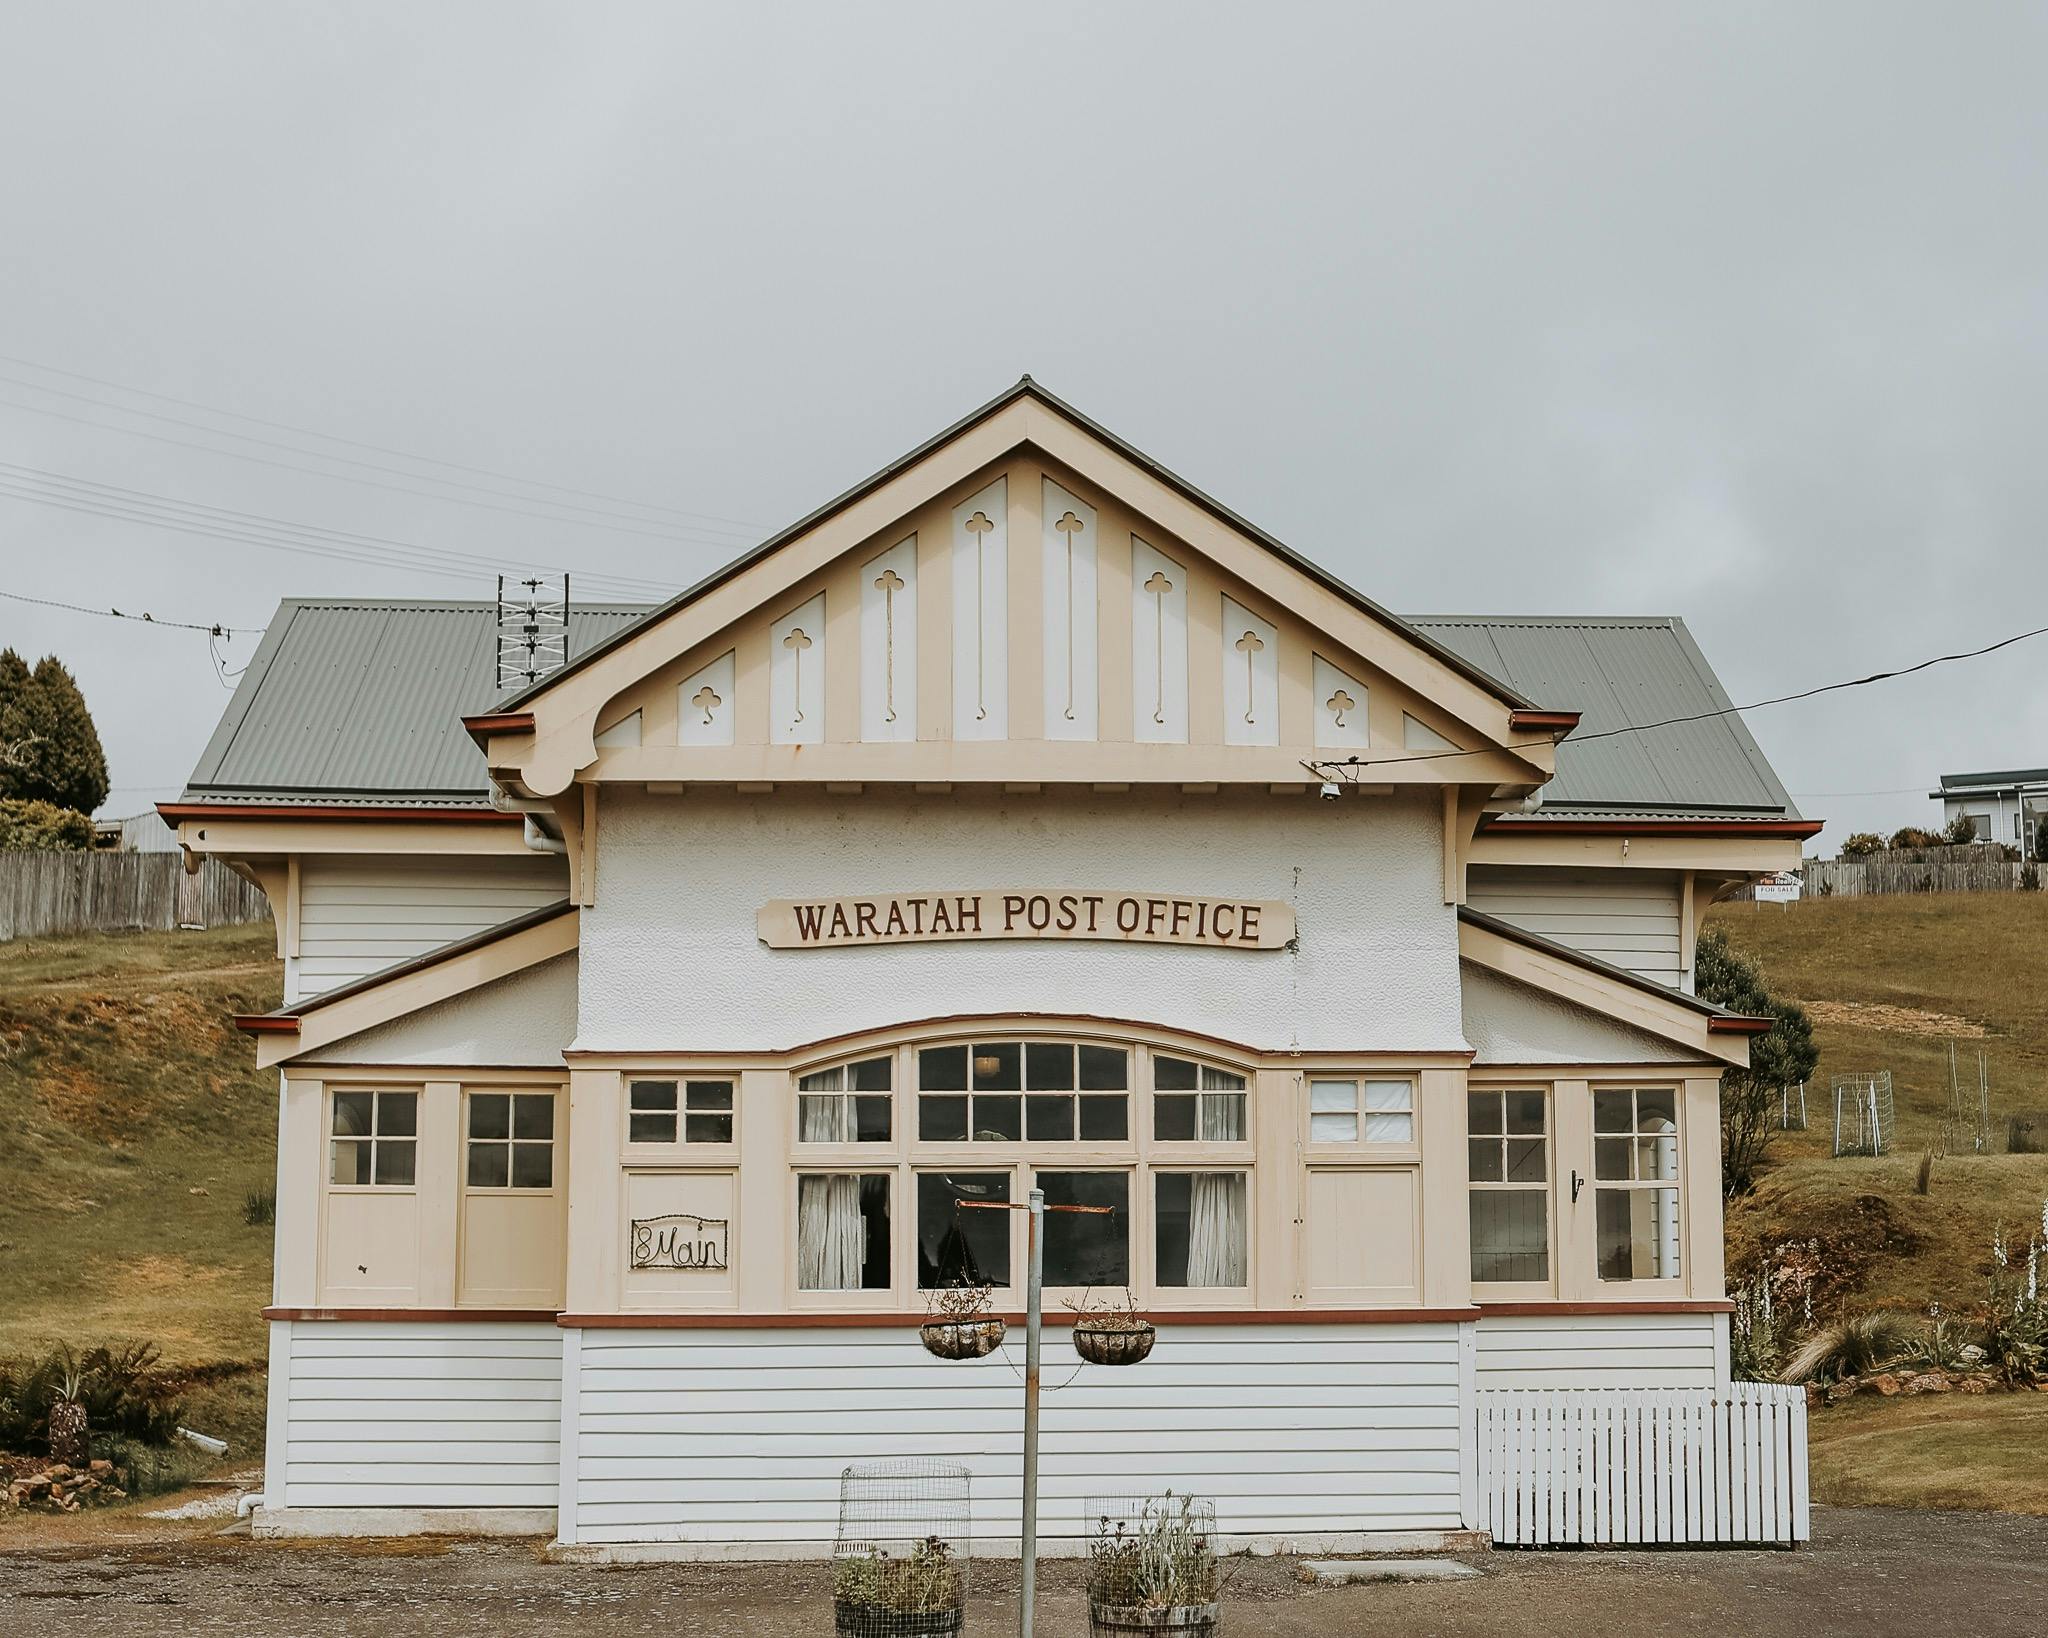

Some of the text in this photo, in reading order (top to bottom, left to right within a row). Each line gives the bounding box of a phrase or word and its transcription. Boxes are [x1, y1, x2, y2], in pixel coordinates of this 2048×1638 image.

[793, 896, 1261, 941] WARATAH POST OFFICE
[635, 1221, 724, 1267] 8 Main
